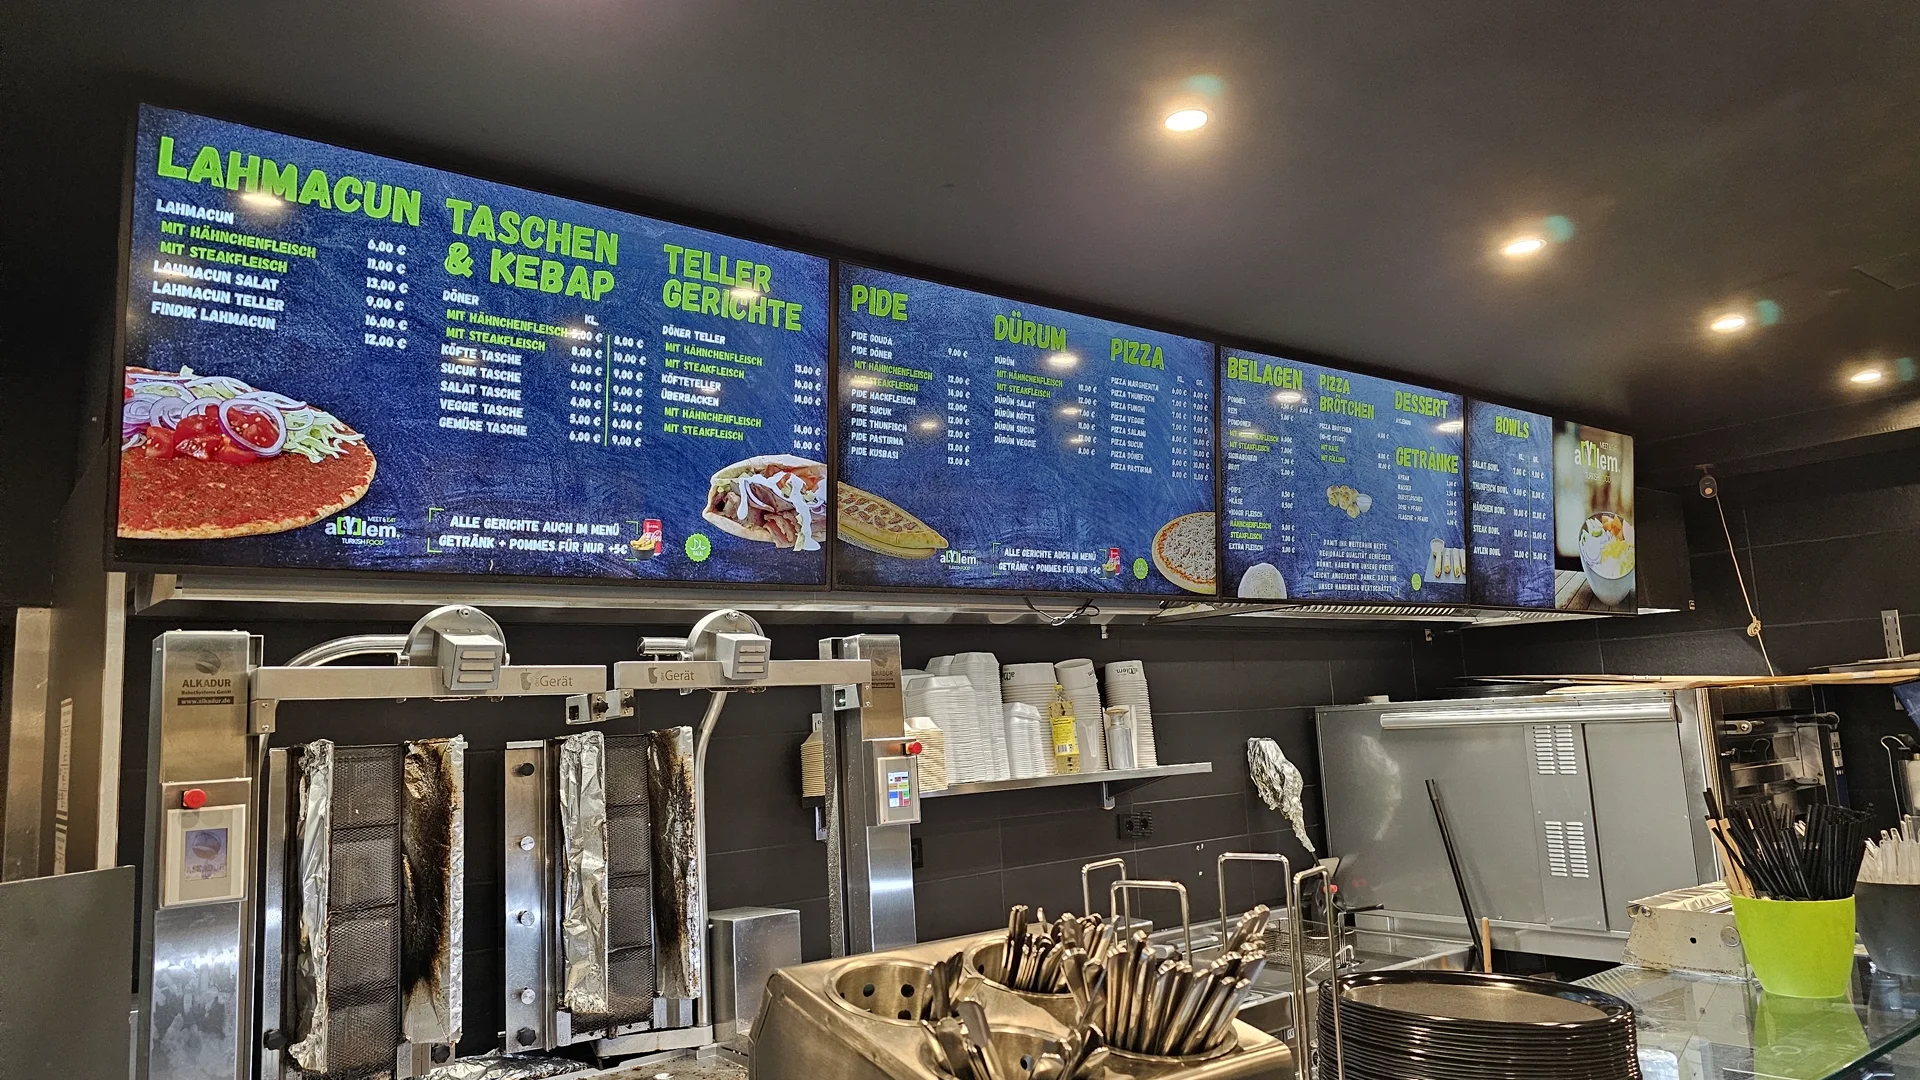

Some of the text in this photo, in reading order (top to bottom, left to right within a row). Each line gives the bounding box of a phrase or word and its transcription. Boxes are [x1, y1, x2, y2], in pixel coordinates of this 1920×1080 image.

[158, 136, 421, 227] LAHMACUN
[156, 199, 234, 224] LAHMACUN
[161, 220, 317, 259] MIT HÄHNCHENFLEISCH
[446, 198, 618, 266] TASCHEN
[160, 242, 288, 273] MIT STEAKFLEISCH
[153, 261, 279, 291] LAHMACUN SALAT
[444, 242, 615, 301] & KEBAP
[663, 244, 772, 293] TELLER
[153, 281, 284, 311] LAHMACUN TELLER
[443, 289, 480, 306] DÖNER
[662, 279, 803, 331] GERICHTE
[852, 285, 909, 321] PIDE
[151, 301, 276, 330] FINDIK LAHMACUN
[446, 309, 569, 338] MIT HÄHNCHENFLEISCH
[446, 327, 546, 352] MIT STEAKFLEISCH
[662, 324, 726, 345] DÖNER TELLER
[851, 331, 893, 346] PIDE GOUDA
[994, 310, 1067, 353] DÜRUM
[441, 343, 522, 366] KÖFTE TASCHE
[665, 342, 763, 366] MIT HÄHNCHENFLEISCH
[851, 346, 893, 360] PIDE DÖNER
[1111, 338, 1165, 371] PIZZA
[441, 363, 522, 383] SUCUK TASCHE
[665, 358, 745, 379] MIT STEAKFLEISCH
[854, 360, 867, 370] MIT
[868, 361, 933, 381] HÄHNCHENFLEISCH
[1227, 357, 1304, 391] BEILAGEN
[440, 381, 522, 401] SALAT TASCHE
[661, 373, 722, 391] KÖFTETELLER
[1008, 385, 1051, 398] STEAKFLEISCH
[1319, 374, 1351, 395] PIZZA
[661, 389, 720, 407] ÜBERBACKEN
[851, 389, 916, 406] PIDE HACKFLEISCH
[1016, 399, 1036, 409] SALAT
[1319, 394, 1375, 420] BRÖTCHEN
[1394, 390, 1449, 419] DESSERT
[440, 398, 523, 419] VEGGIE TASCHE
[664, 407, 762, 428] MIT HÄHNCHENFLEISCH
[851, 403, 892, 417] PIDE SUCUK
[439, 415, 528, 437] GEMÜSE TASCHE
[664, 423, 744, 441] MIT STEAKFLEISCH
[851, 418, 907, 432] PIDE THUNFISCH
[1016, 425, 1035, 435] SUCUK
[1495, 416, 1530, 439] BOWLS
[851, 432, 867, 442] PIDE
[851, 446, 867, 456] PIDE
[1396, 446, 1459, 474] GETRÄNKE
[450, 516, 620, 536] ALLE GERICHTE AUCH IM MENÜ
[439, 534, 496, 549] GETRÄNK
[498, 540, 507, 548] +
[509, 538, 555, 552] POMMES
[559, 538, 578, 552] FÜR
[583, 542, 604, 554] NUR
[1004, 548, 1020, 557] ALLE
[1021, 549, 1052, 559] GERICHTE
[1053, 550, 1070, 560] AUCH
[998, 560, 1029, 571] GETRÄNK
[1036, 564, 1061, 573] POMMES
[1063, 563, 1075, 573] FÜR
[1076, 566, 1088, 574] NUR
[182, 679, 232, 688] ALKADUR
[539, 675, 573, 687] Gerät
[664, 670, 695, 682] Gerät
